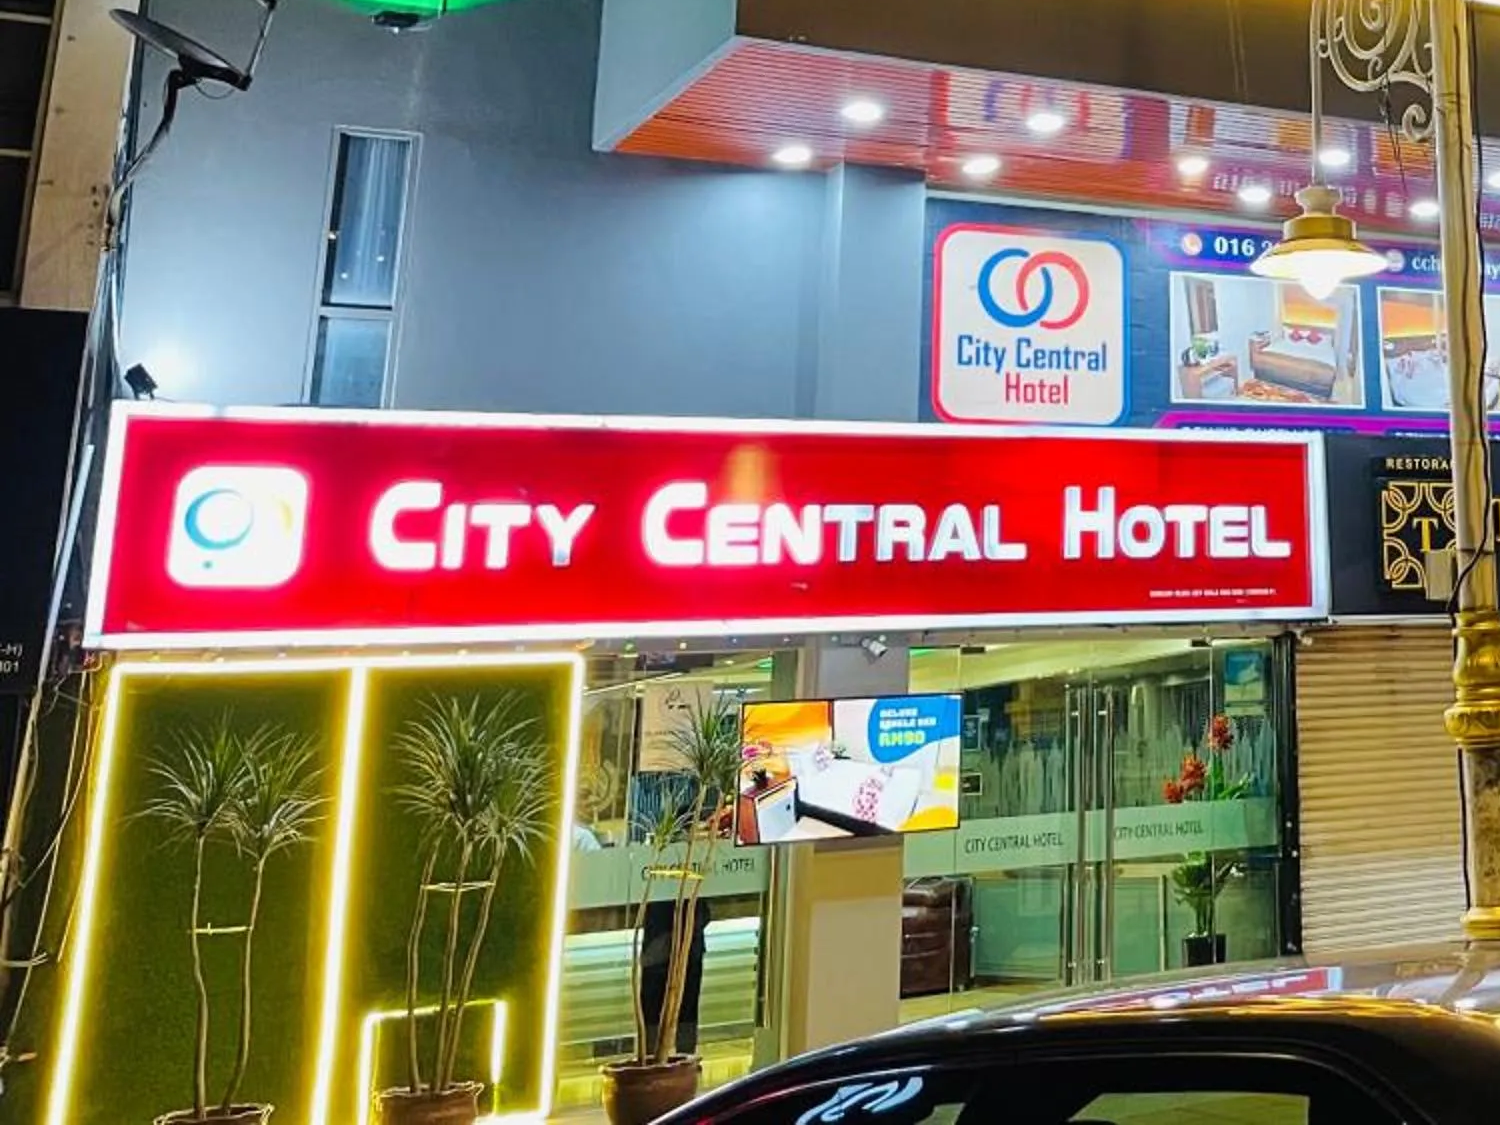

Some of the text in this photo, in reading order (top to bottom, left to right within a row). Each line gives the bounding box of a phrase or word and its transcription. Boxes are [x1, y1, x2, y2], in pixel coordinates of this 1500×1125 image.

[1213, 236, 1255, 257] 016
[957, 334, 1107, 374] City Central
[1005, 372, 1069, 405] Hotel
[369, 481, 1291, 572] CITY CENTRAL HOTEL
[1412, 517, 1439, 552] T
[964, 837, 986, 854] CITY
[1033, 832, 1065, 847] HOTEL
